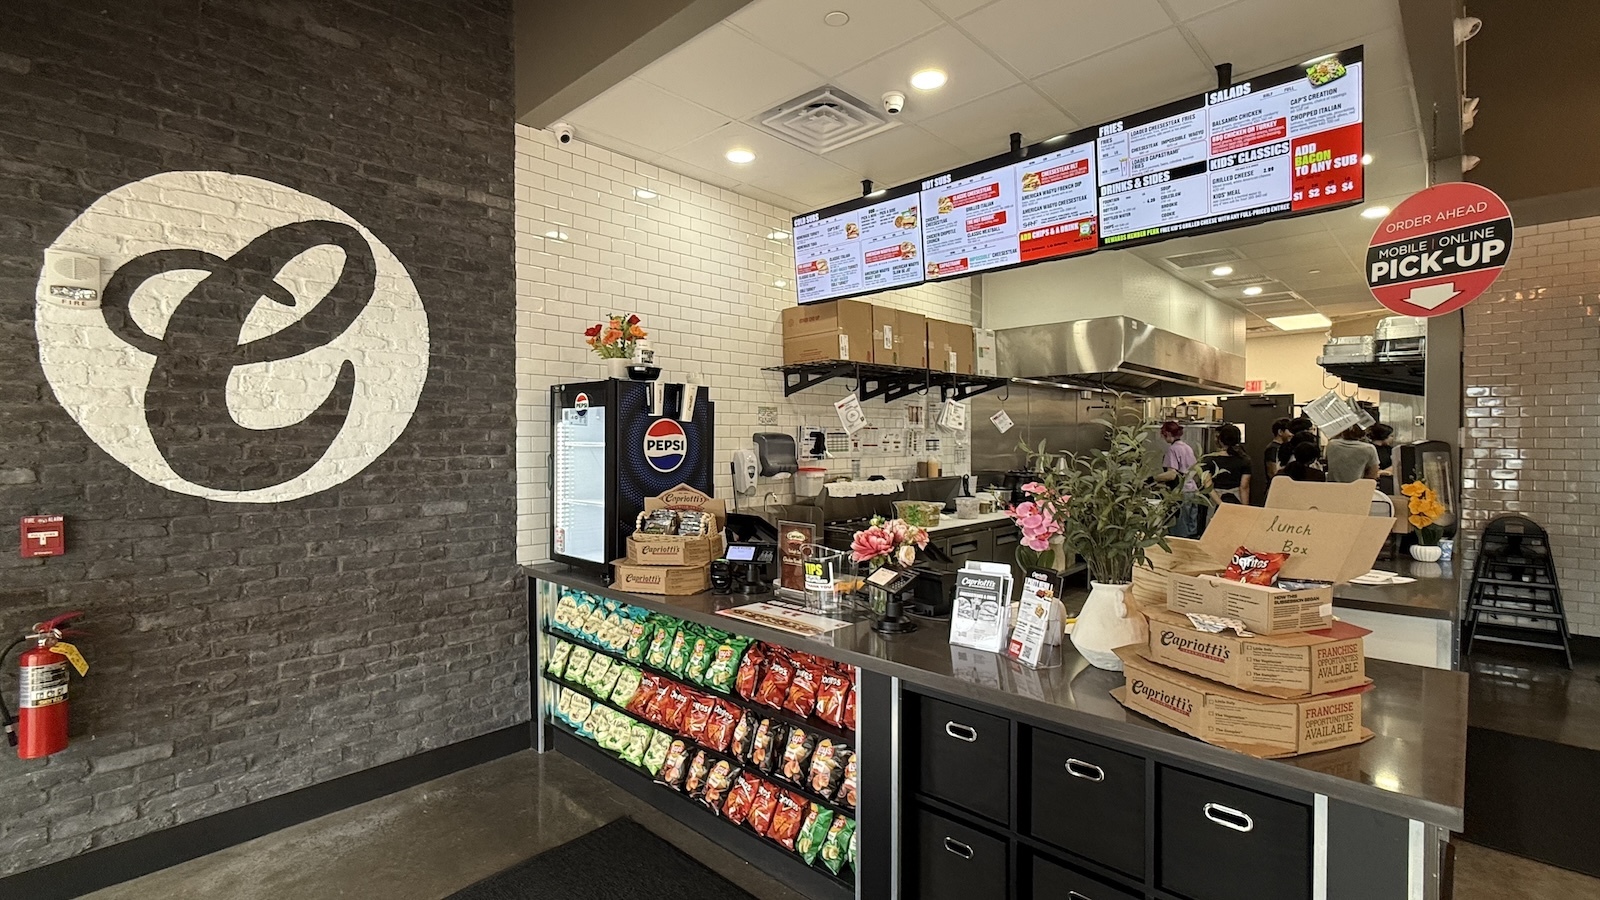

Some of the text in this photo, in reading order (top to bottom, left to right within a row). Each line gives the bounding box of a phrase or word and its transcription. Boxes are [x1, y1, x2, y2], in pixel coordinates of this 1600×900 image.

[1209, 83, 1251, 105] SALADS
[1290, 87, 1338, 106] CAP'S CREATION
[1212, 115, 1238, 127] BALSAMIC
[1239, 109, 1262, 120] CHICKEN
[1290, 109, 1318, 121] CHOPPED
[1318, 103, 1342, 115] ITALIAN
[1099, 121, 1124, 138] FRIES
[1131, 127, 1147, 137] LOADED
[1148, 118, 1180, 132] CHEESESTEAK
[1181, 114, 1196, 122] FRIES
[1224, 128, 1247, 138] CHICKEN
[1255, 120, 1278, 131] TURKEY
[1131, 142, 1159, 153] CHEESESTEAK
[1160, 134, 1187, 145] IMPOSSIBLE
[1295, 143, 1317, 156] ADD
[1131, 156, 1149, 165] LOADED
[1210, 142, 1290, 171] KIDS' CLASSICS
[1295, 149, 1331, 167] BACON
[1295, 153, 1358, 177] TO ANY SUB
[921, 174, 952, 191] HOT SUBS
[1101, 171, 1170, 196] DRINKS & SIDES
[1212, 170, 1254, 185] GRILLED CHEESE
[1022, 190, 1042, 201] AMERICAN
[1057, 184, 1074, 193] FRENCH
[1227, 189, 1241, 197] MEAL
[1022, 205, 1042, 215] AMERICAN
[1058, 195, 1087, 207] CHEESESTEAK
[1104, 234, 1127, 244] REWARDS
[1146, 227, 1160, 236] PERK
[1200, 216, 1217, 225] CHEESE
[1240, 206, 1271, 218] FULL-PRICED
[1385, 201, 1488, 234] ORDER AHEAD
[1032, 228, 1049, 239] CHIPS
[1060, 223, 1079, 233] DRINK
[1378, 226, 1496, 260] MOBILE ONLINE
[992, 248, 1018, 257] CHEESESTEAK
[1371, 239, 1506, 283] PICK-UP
[1246, 381, 1263, 392] EXIT
[647, 440, 684, 451] PEPSI
[665, 494, 704, 504] Capriotti's
[1266, 515, 1312, 536] lunch
[642, 545, 680, 555] Capriotti's
[1282, 539, 1308, 555] Box
[805, 562, 823, 576] TIPS
[1232, 554, 1271, 569] Doritos
[626, 573, 661, 584] Capriotti's
[961, 577, 996, 588] Capriotti's
[1160, 630, 1231, 660] Capriotti's
[1317, 643, 1358, 659] FRANCHISE
[1317, 653, 1359, 667] OPPORTUNITIES
[1317, 662, 1359, 679] AVAILABLE
[1131, 679, 1193, 713] Capriotti's
[1305, 702, 1354, 719] FRANCHISE
[1305, 713, 1354, 729] OPPORTUNITIES
[1304, 722, 1354, 740] AVAILABLE
